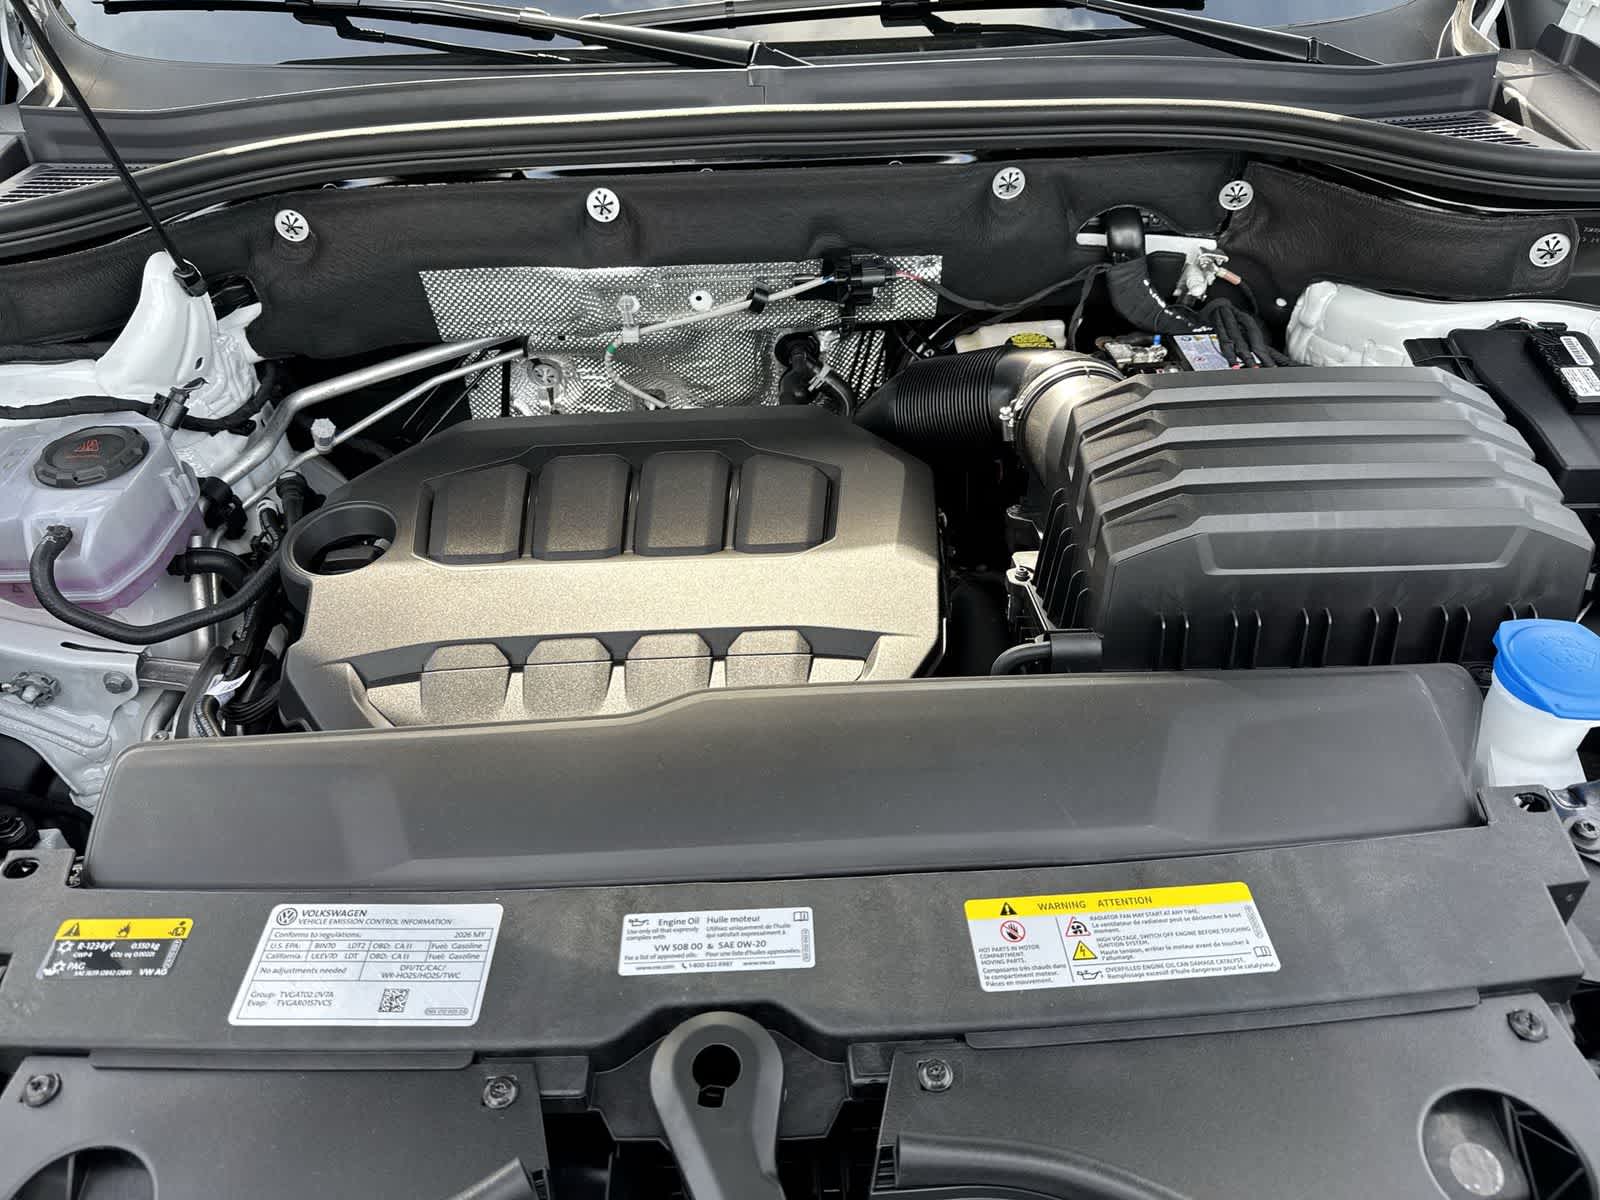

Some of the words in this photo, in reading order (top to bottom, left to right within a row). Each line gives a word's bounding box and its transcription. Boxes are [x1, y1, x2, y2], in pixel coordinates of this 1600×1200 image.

[1037, 900, 1086, 910] WARNING
[1098, 896, 1152, 907] ATTENTION
[302, 909, 368, 917] VOLKSWAGEN
[658, 919, 686, 927] Engine
[706, 915, 728, 923] Huile
[730, 915, 760, 923] moteur
[672, 943, 689, 951] 508
[718, 941, 735, 949] SAE
[736, 940, 767, 948] 0W-20
[448, 952, 480, 960] Gasoline
[66, 962, 87, 971] PAG
[139, 968, 154, 976] VW
[154, 968, 169, 976] AG
[272, 967, 318, 976] adjustments
